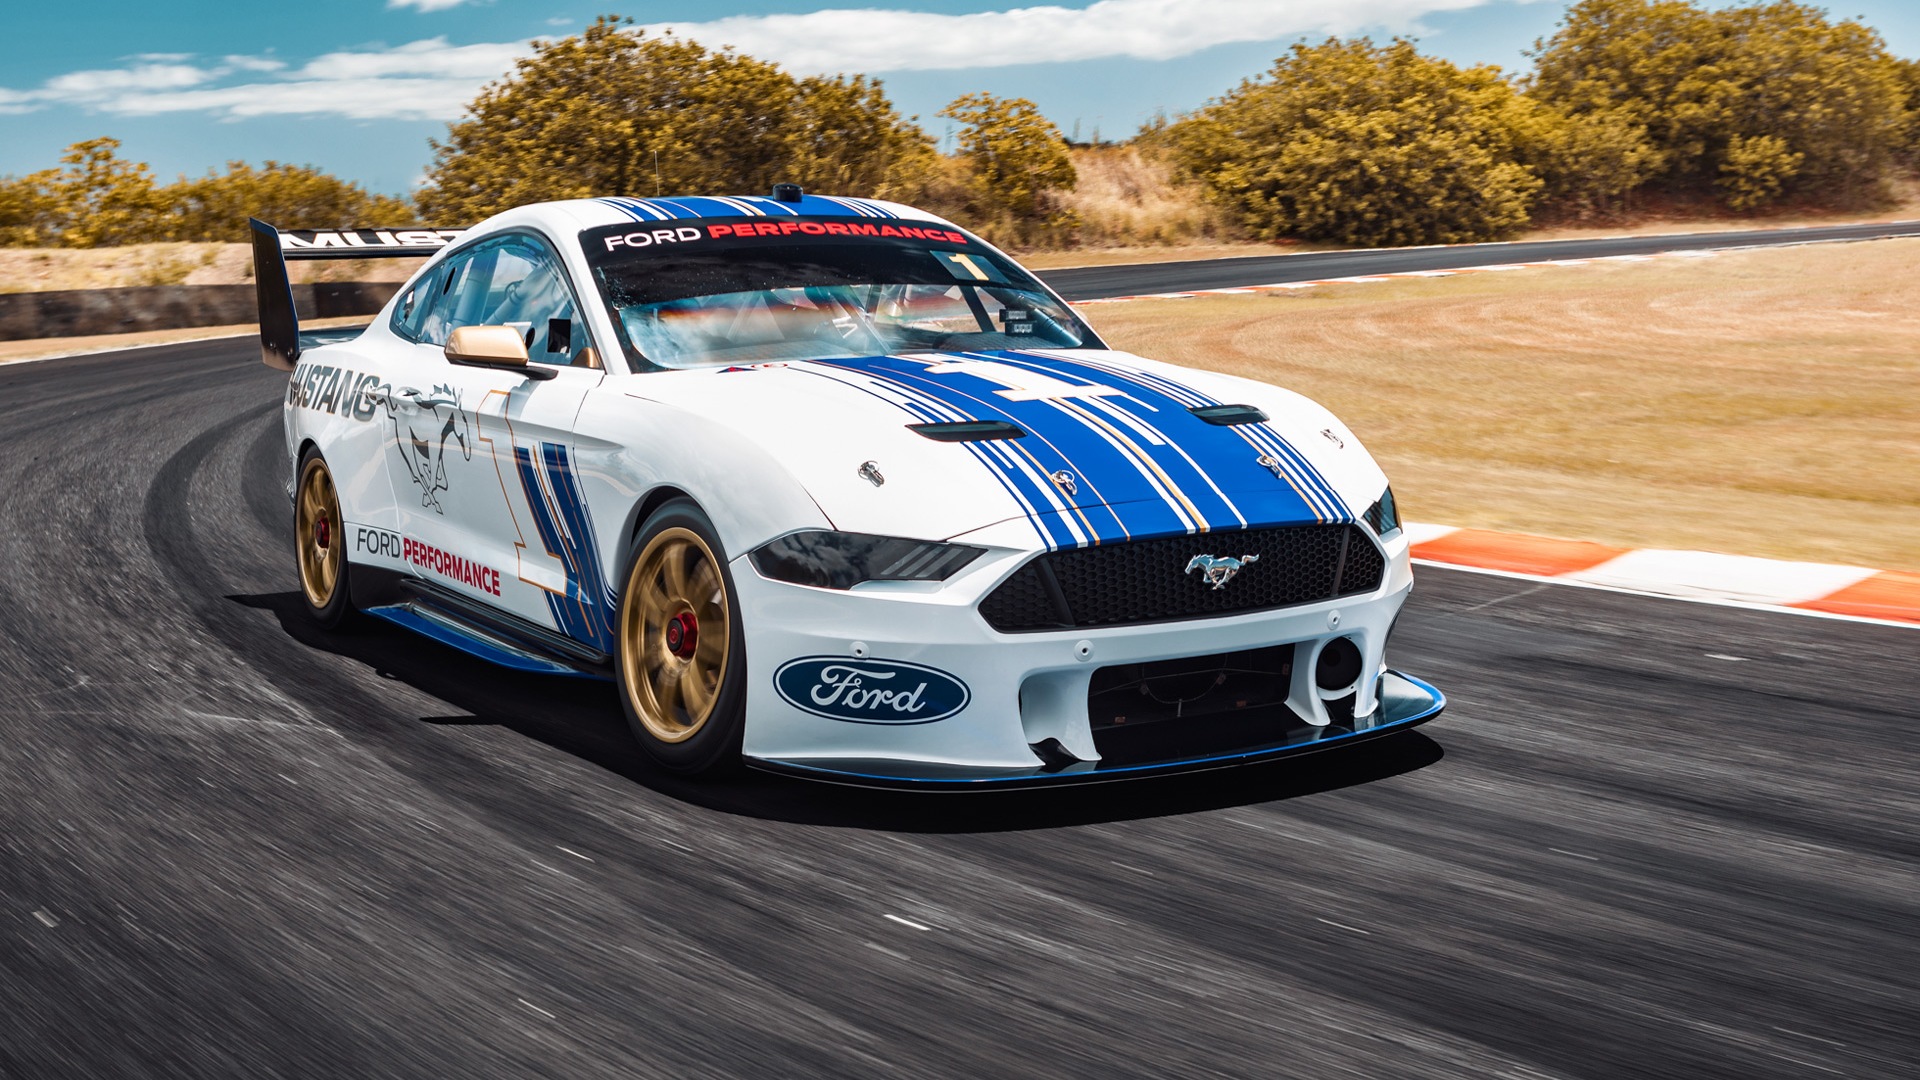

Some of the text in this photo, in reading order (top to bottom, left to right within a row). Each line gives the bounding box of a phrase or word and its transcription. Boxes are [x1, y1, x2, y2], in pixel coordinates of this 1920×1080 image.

[604, 221, 968, 252] FORD PERFORMANCE
[949, 253, 990, 281] 1
[289, 363, 381, 422] MUSTANG
[356, 527, 501, 597] FORD PERFORMANCE
[810, 665, 928, 713] Ford
